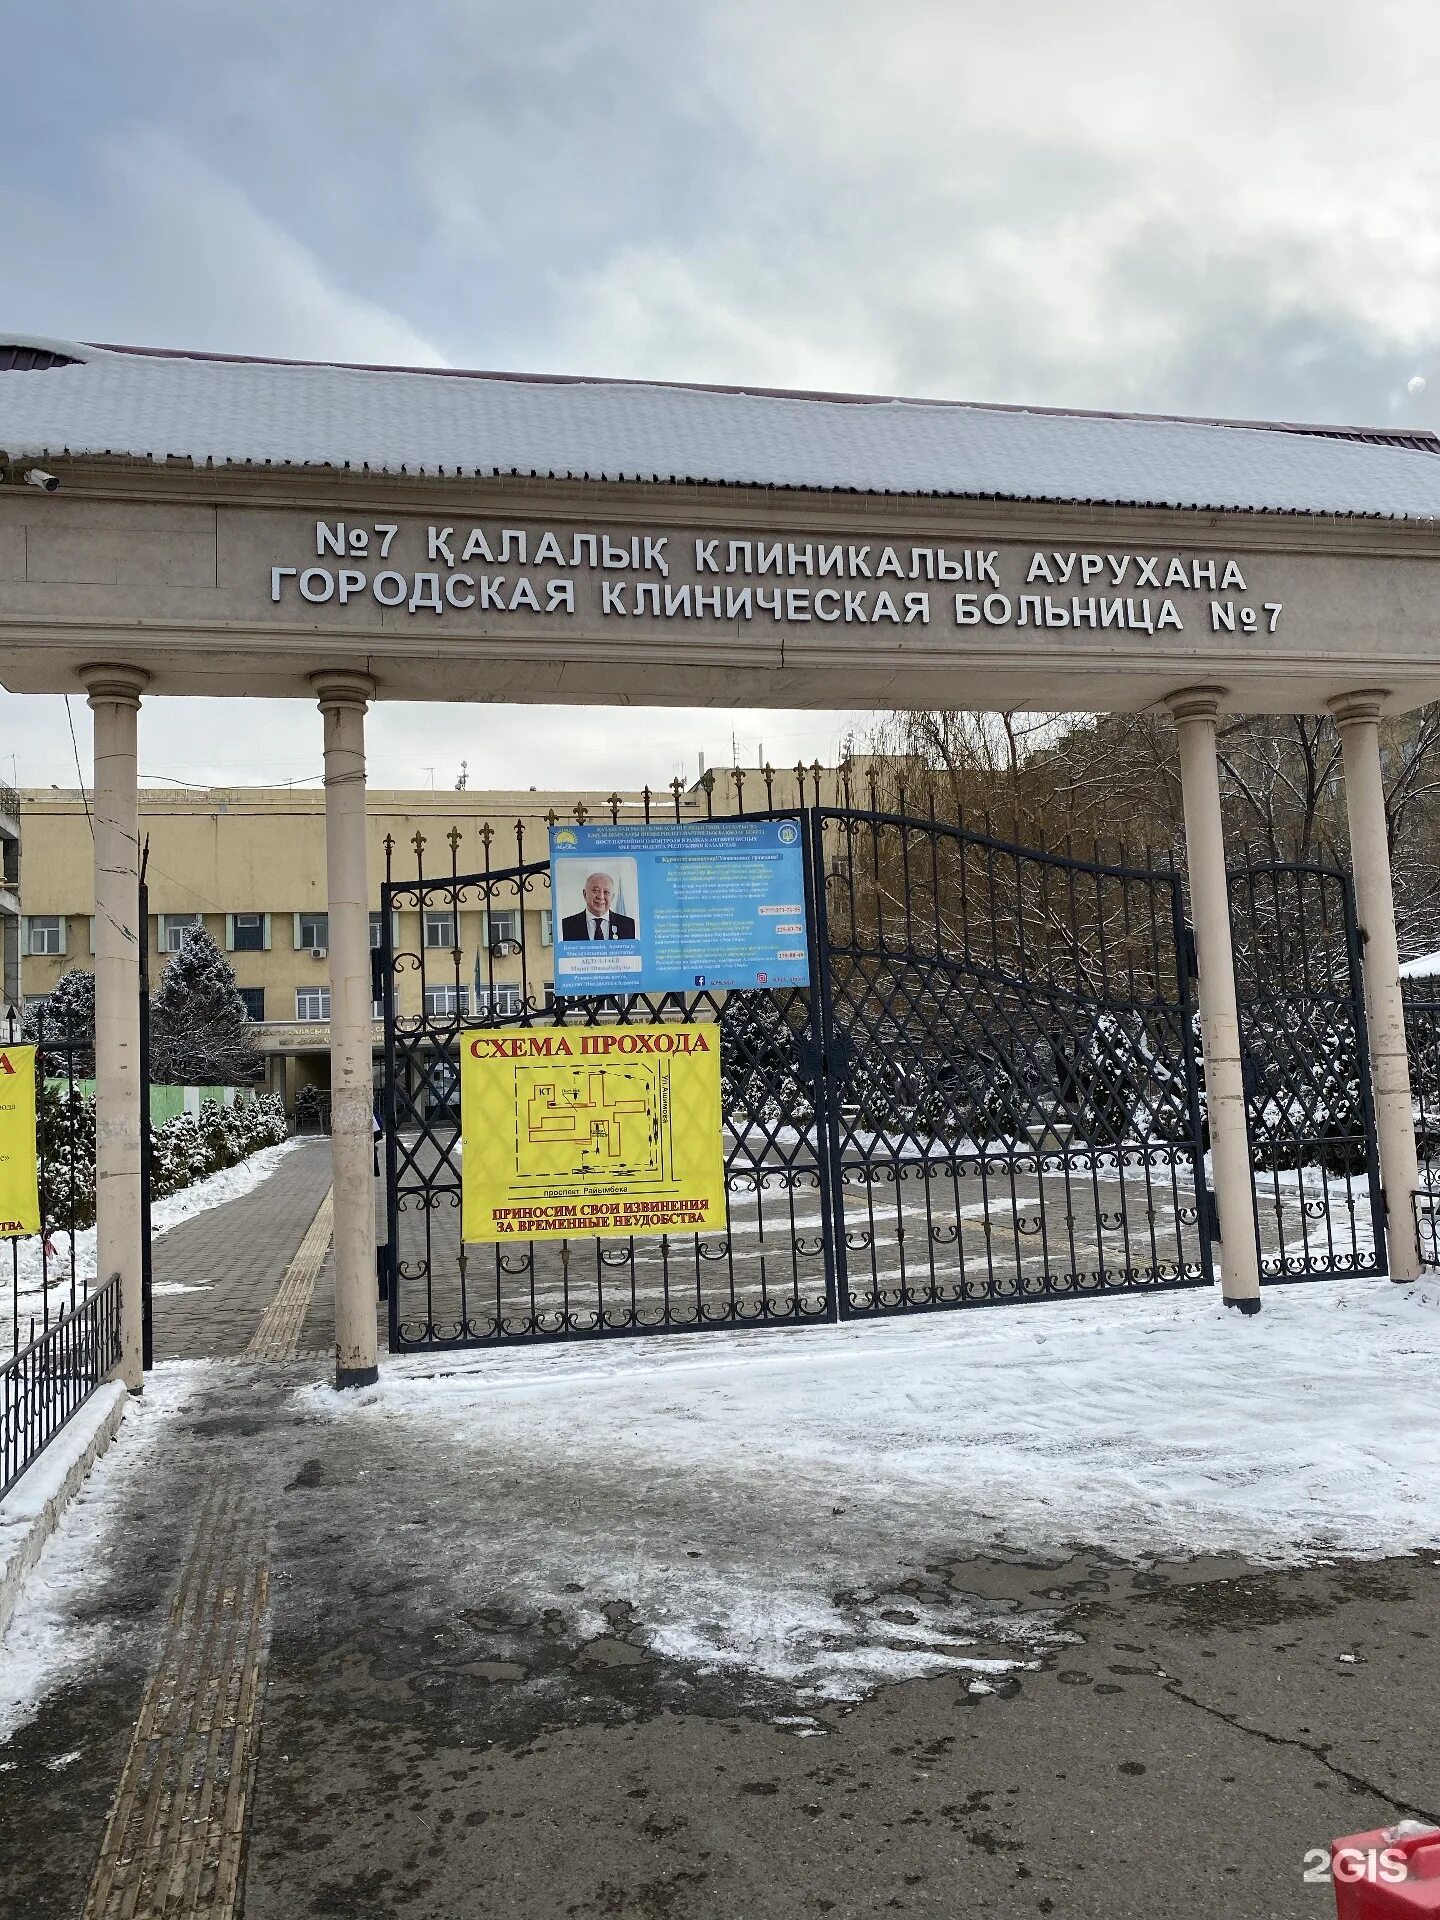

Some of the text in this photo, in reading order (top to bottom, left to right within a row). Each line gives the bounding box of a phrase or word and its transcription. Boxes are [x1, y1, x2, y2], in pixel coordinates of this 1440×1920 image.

[315, 521, 1248, 591] №7 ҚАЛАЛЫҚ КЛИНИКАЛЫҚ АУРУХАНА
[270, 566, 1285, 635] ГОРОДСКАЯ КЛИНИЧЕСКАЯ БОЛЬНИЦА №7
[470, 1032, 710, 1059] СХЕМА ПРОХОДА
[539, 1088, 551, 1096] КТ
[543, 1184, 628, 1198] проспект Райымбека
[492, 1199, 709, 1221] ПРИНОСИМ СВОИ ИЗВИНЕНИЯ
[496, 1211, 706, 1233] ЗА ВРЕМЕННЫЕ НЕУДОБСТВА
